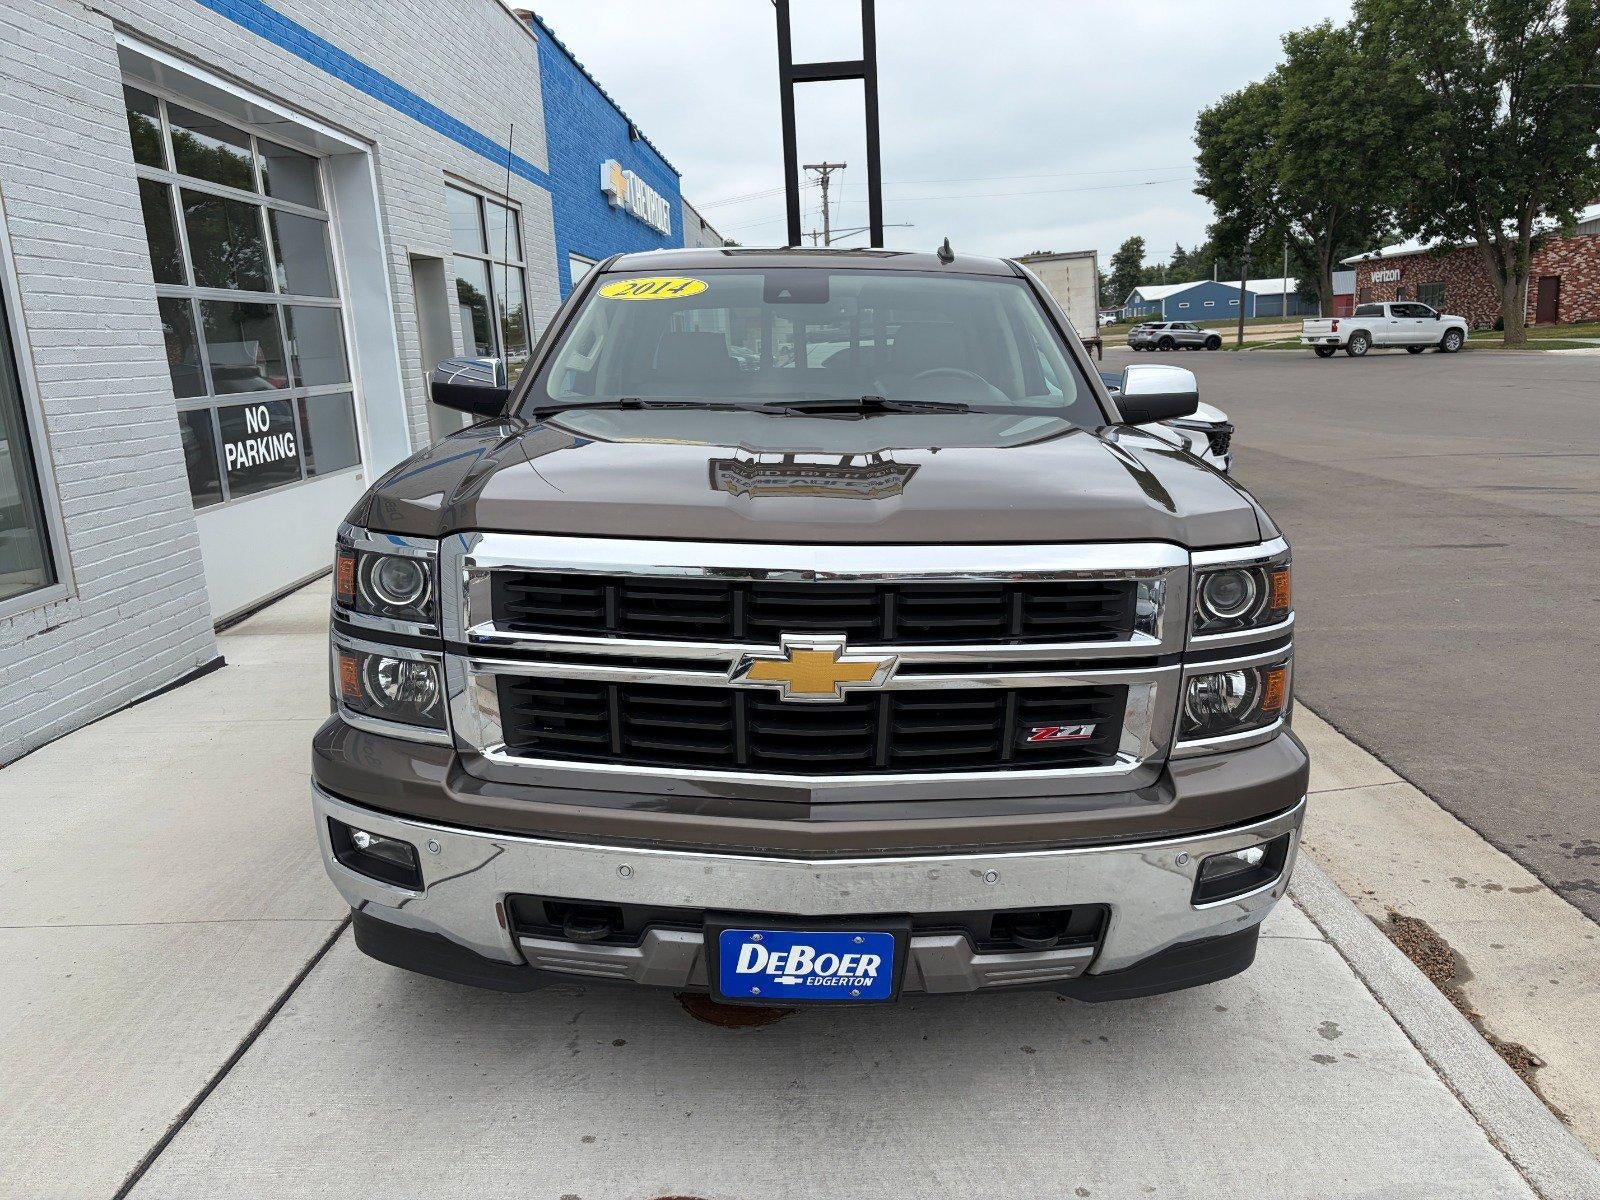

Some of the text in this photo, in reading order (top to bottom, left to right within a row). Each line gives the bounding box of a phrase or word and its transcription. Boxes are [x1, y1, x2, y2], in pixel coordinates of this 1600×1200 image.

[1371, 267, 1400, 282] verizon
[612, 280, 694, 297] 2014
[244, 405, 270, 434] NO
[224, 432, 297, 471] PARKING
[1027, 723, 1097, 741] Z71
[806, 976, 874, 987] EDGERTON
